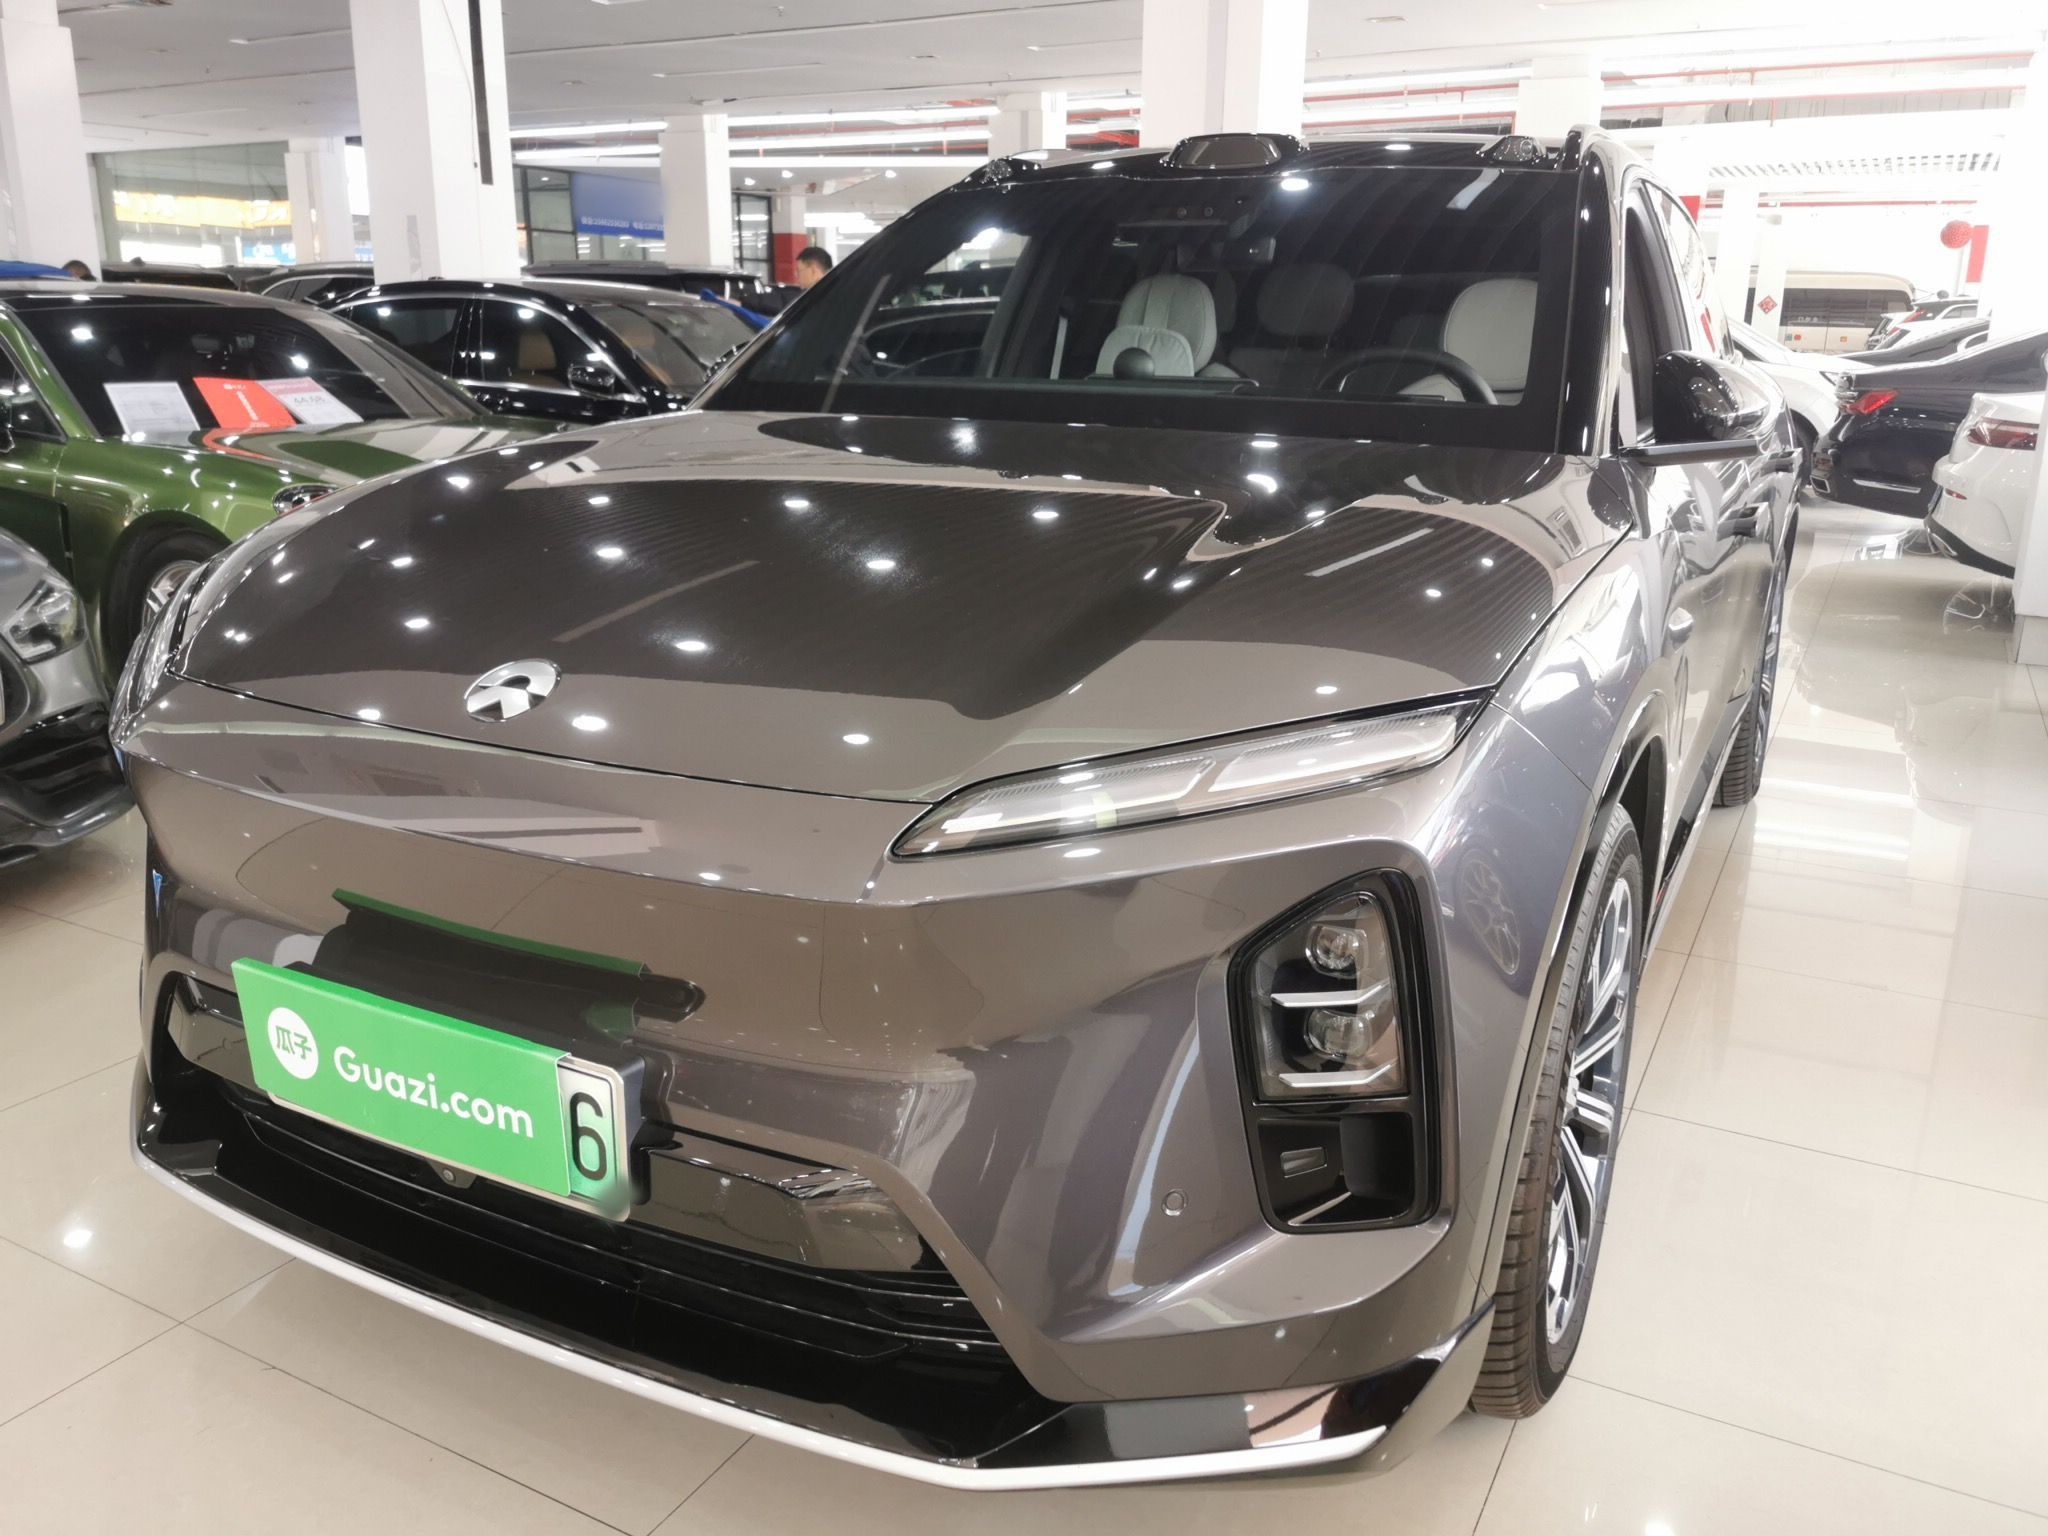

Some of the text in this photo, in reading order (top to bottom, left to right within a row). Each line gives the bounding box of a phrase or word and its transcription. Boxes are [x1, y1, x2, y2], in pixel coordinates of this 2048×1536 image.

[275, 1025, 312, 1060] 瓜子
[334, 1045, 534, 1139] Guazi.com
[569, 1091, 608, 1182] 6
